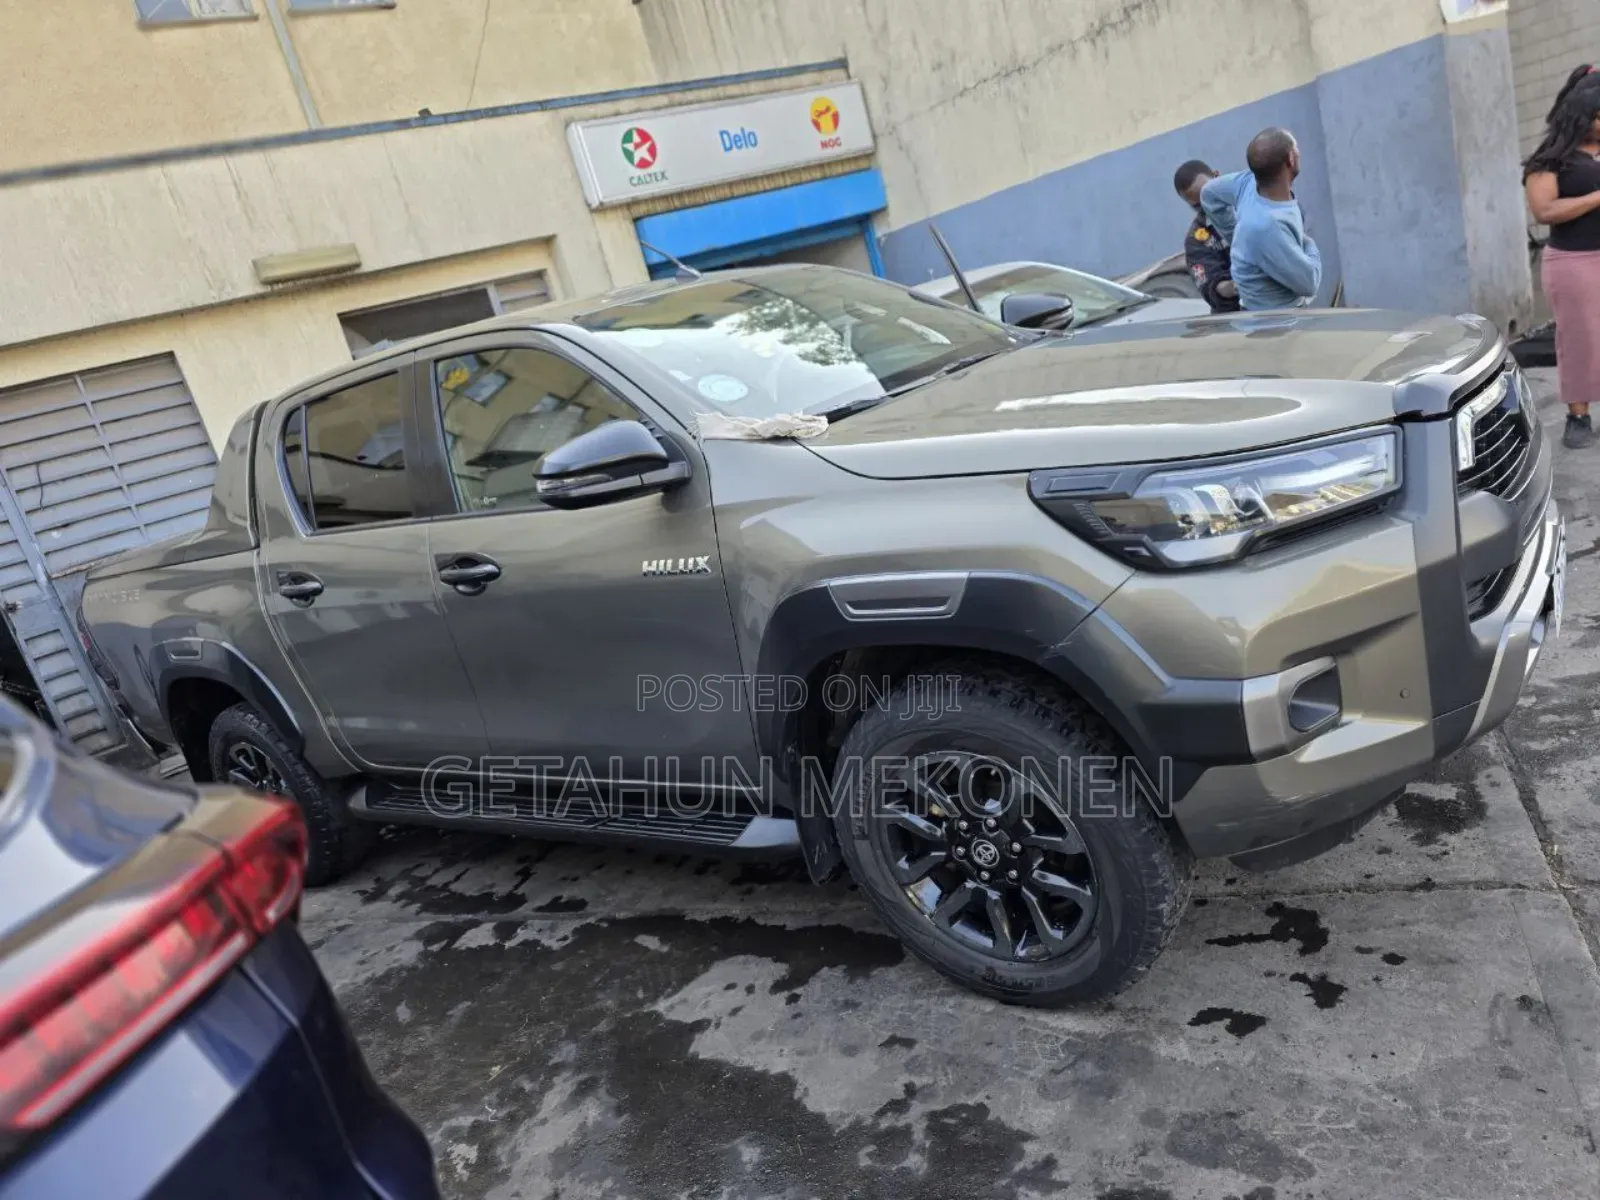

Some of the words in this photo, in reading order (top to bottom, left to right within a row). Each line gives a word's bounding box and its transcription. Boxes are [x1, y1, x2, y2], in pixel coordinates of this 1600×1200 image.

[719, 126, 758, 152] Delo
[629, 170, 669, 187] CALTEX
[642, 555, 711, 576] HILUX
